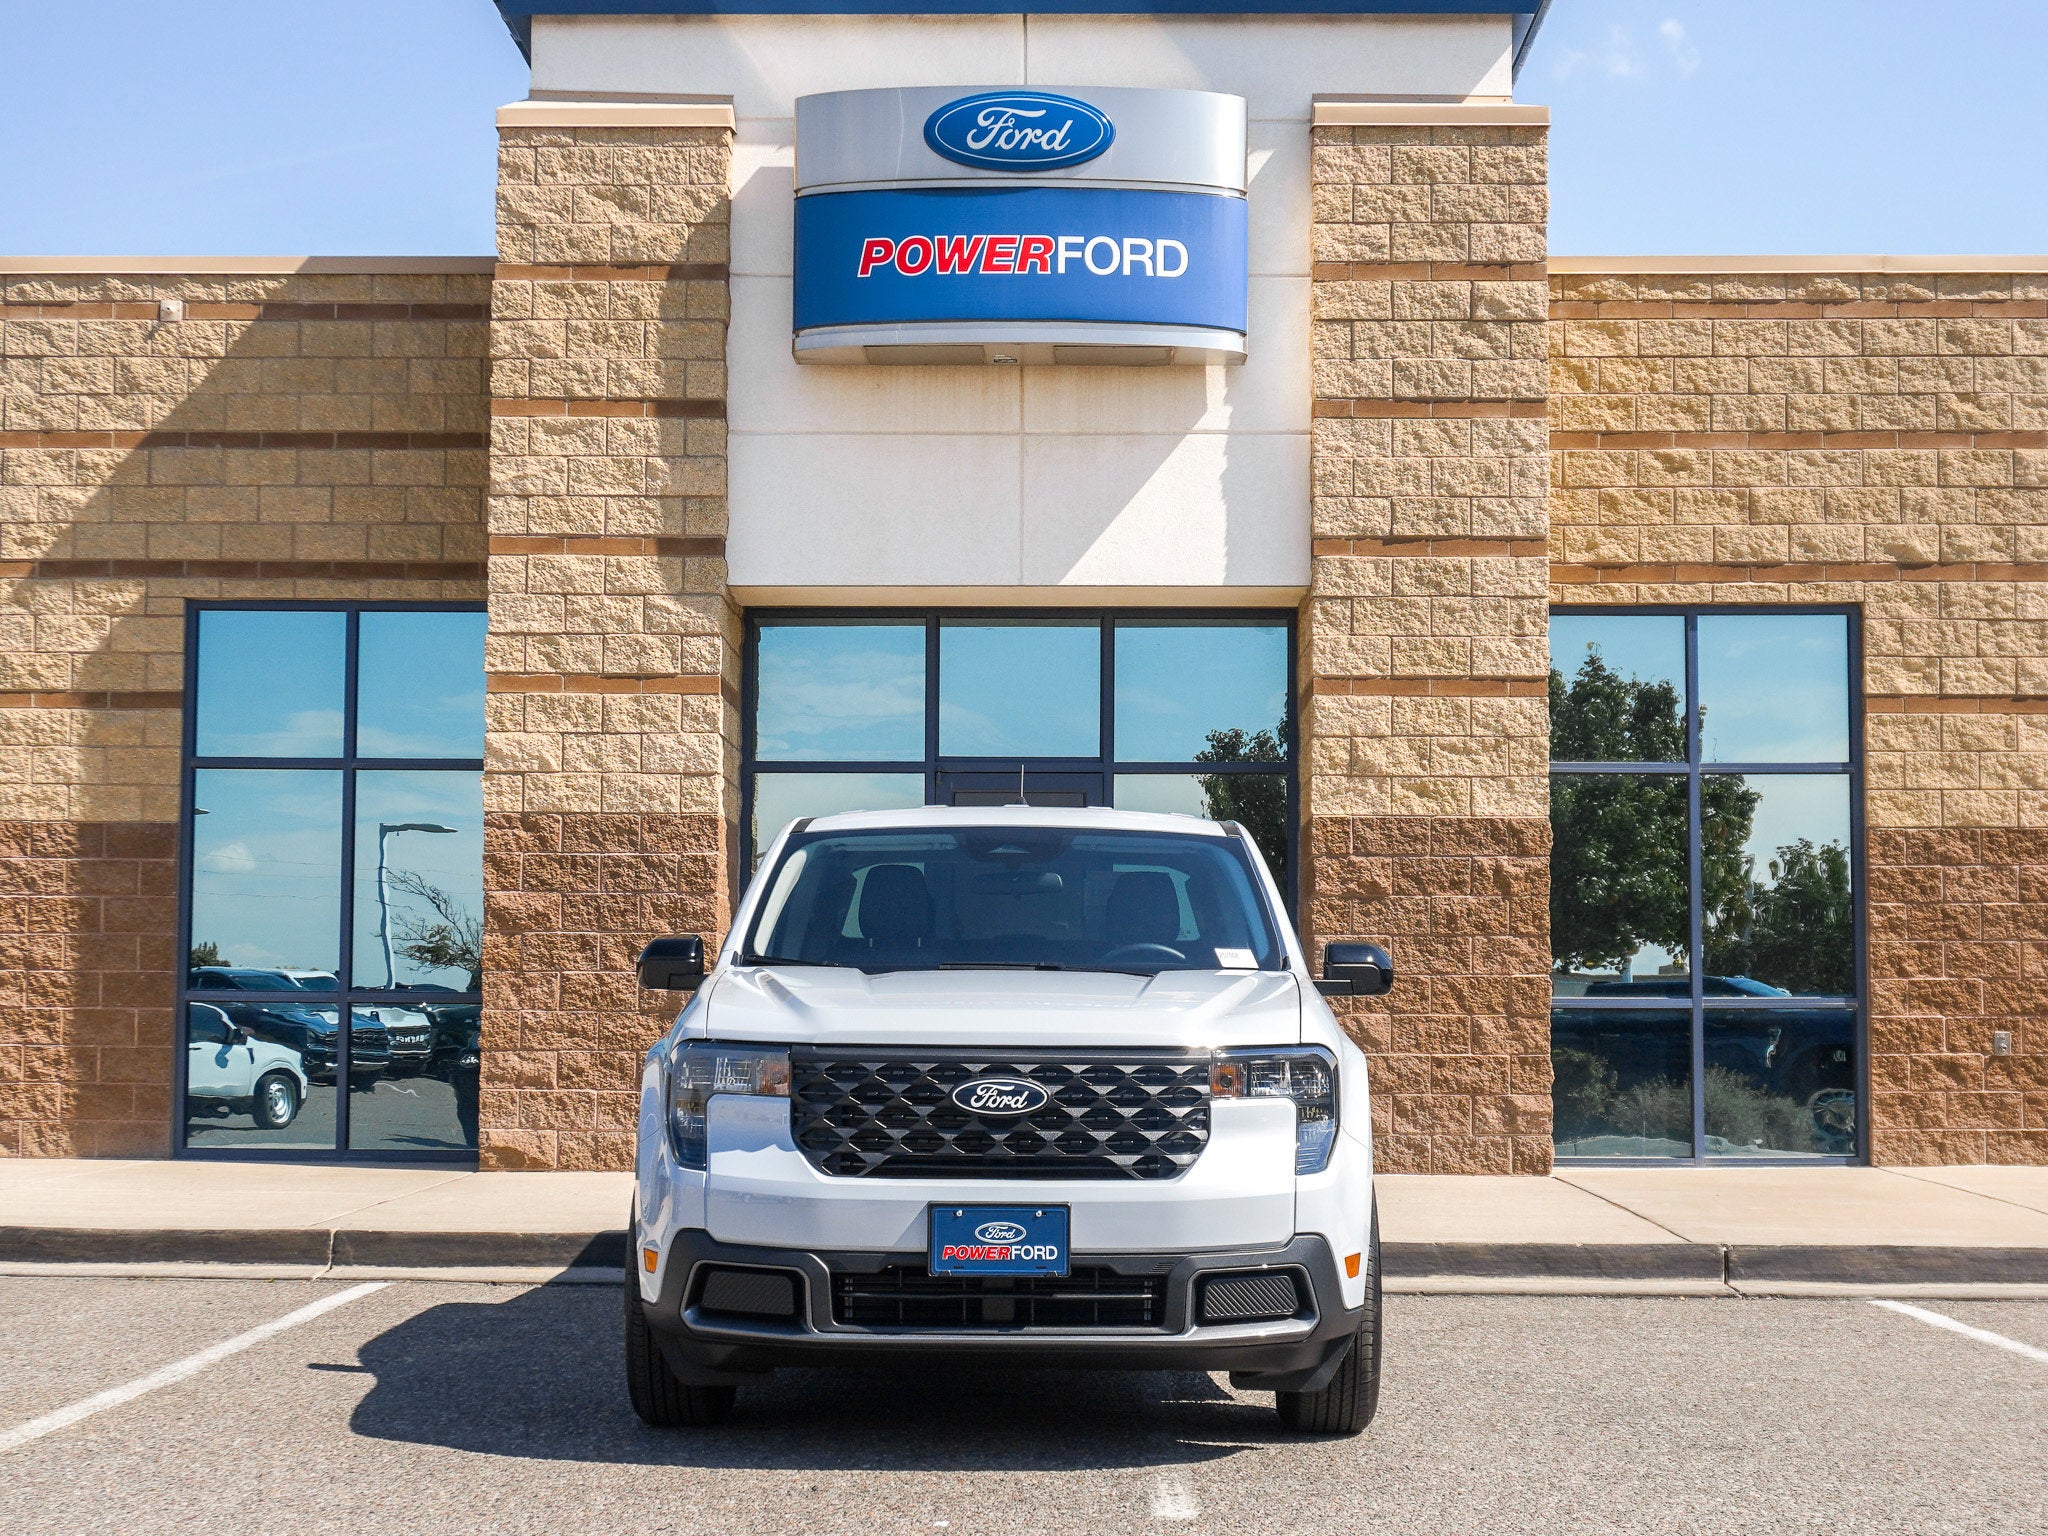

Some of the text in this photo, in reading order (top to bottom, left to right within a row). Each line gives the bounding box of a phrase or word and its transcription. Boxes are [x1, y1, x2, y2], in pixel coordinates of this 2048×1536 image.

[966, 106, 1073, 151] Ford
[970, 1083, 1030, 1109] Ford
[985, 1224, 1016, 1240] Ford
